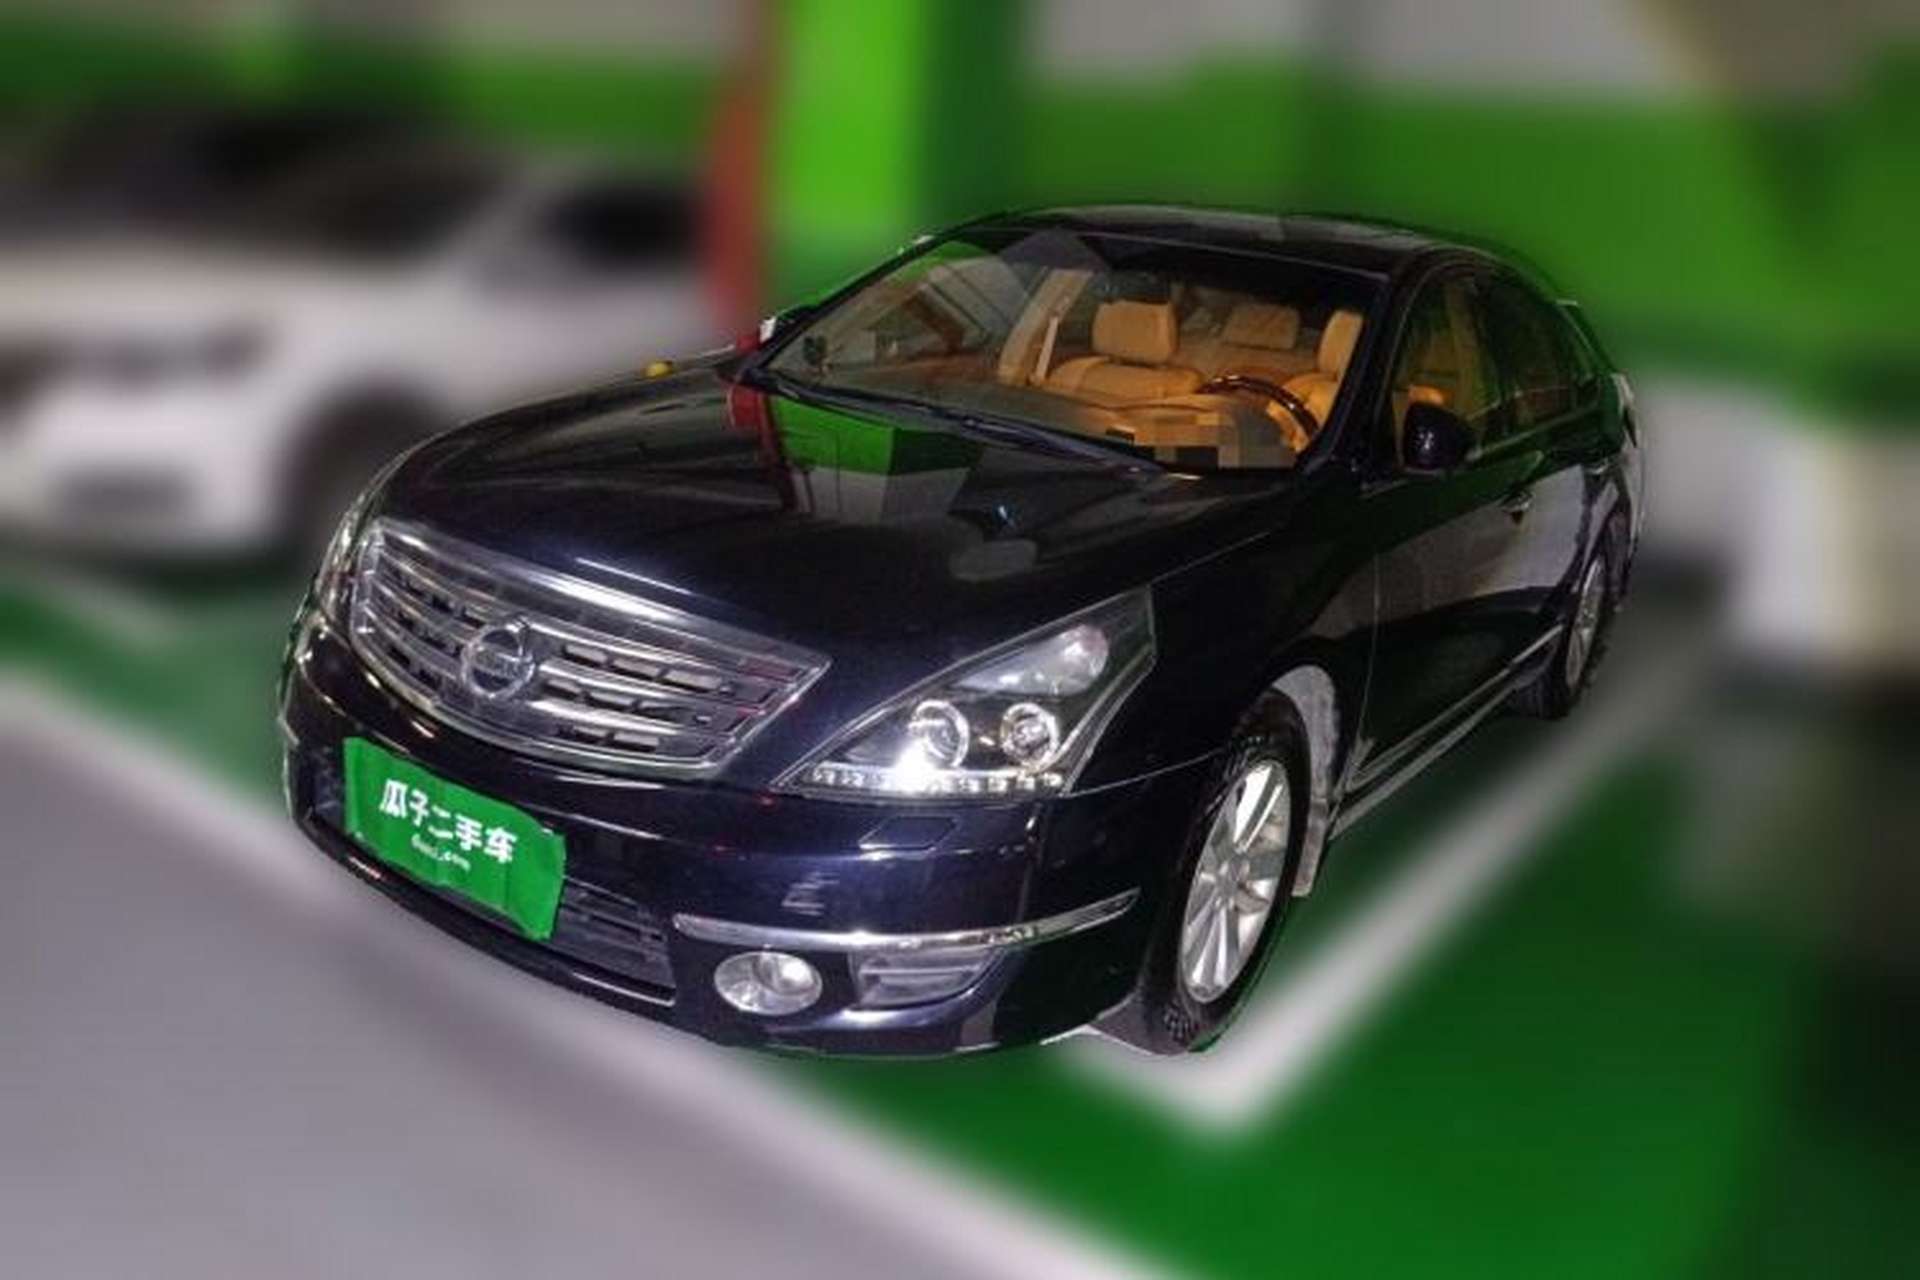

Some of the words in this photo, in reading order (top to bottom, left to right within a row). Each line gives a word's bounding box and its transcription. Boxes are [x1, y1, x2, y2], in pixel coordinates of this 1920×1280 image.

[379, 779, 517, 863] 瓜子二手车
